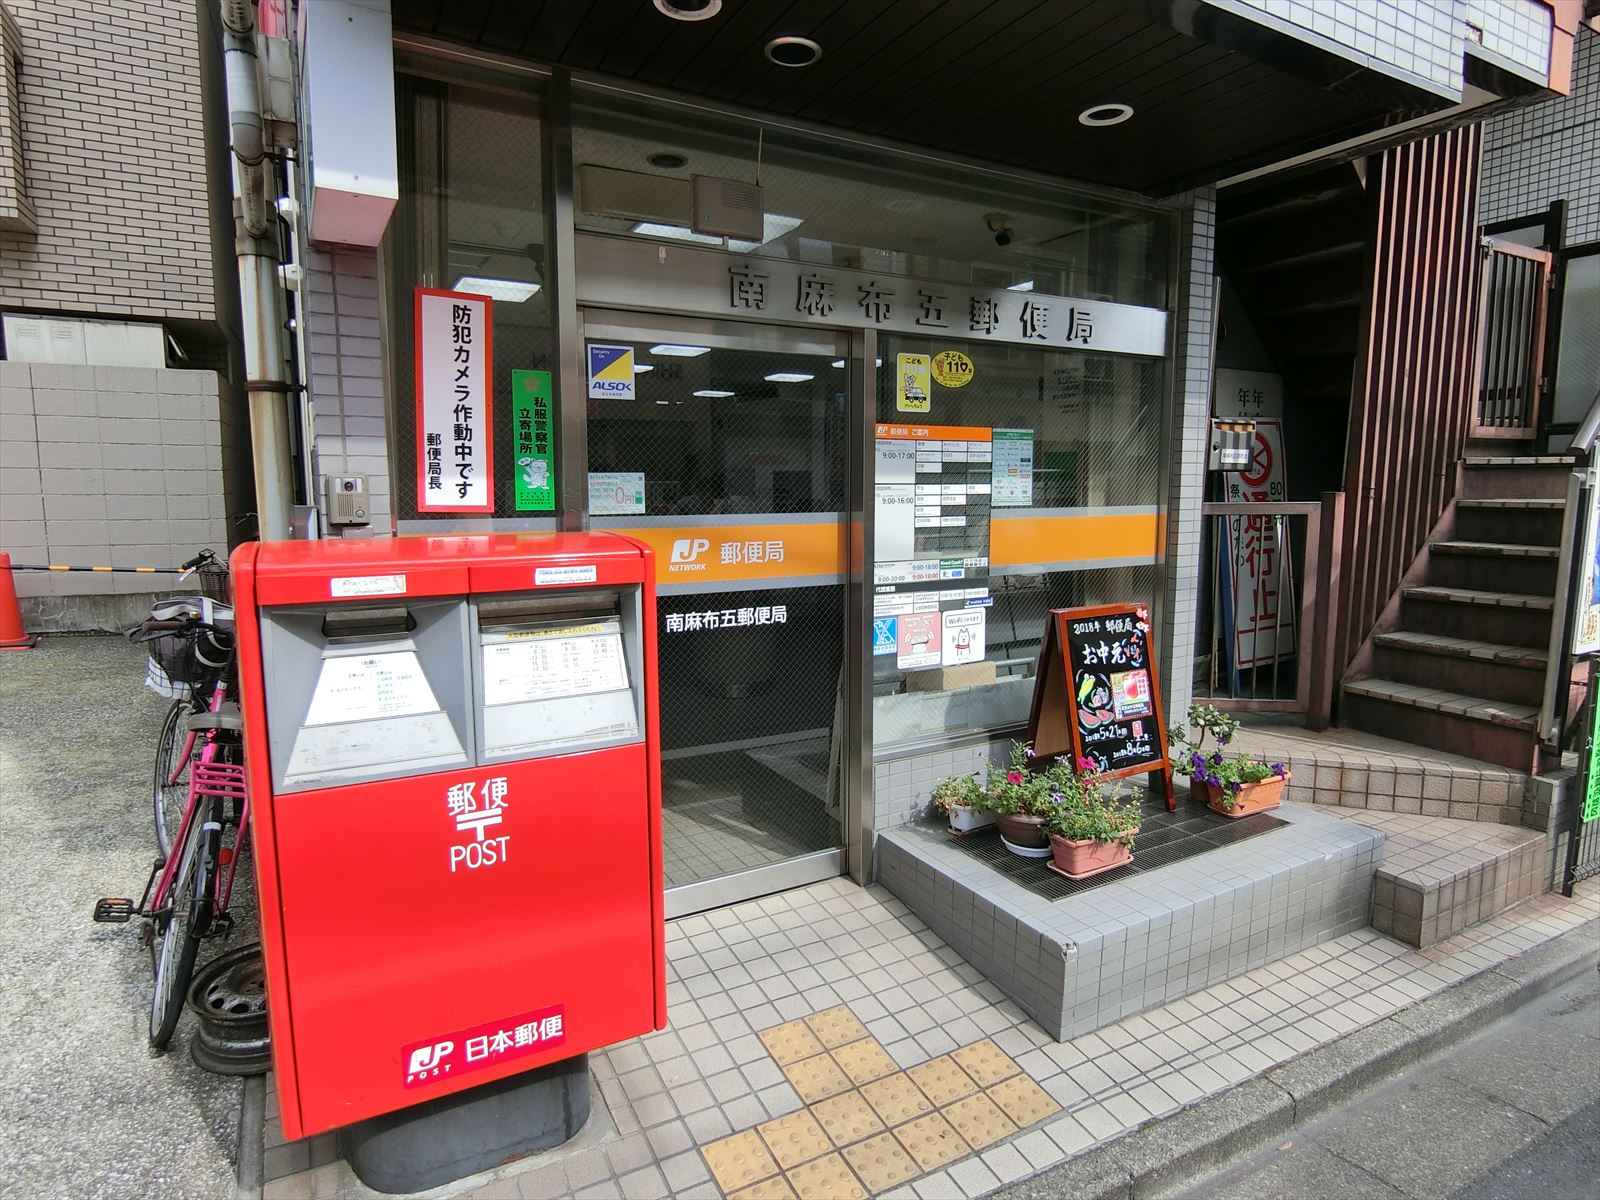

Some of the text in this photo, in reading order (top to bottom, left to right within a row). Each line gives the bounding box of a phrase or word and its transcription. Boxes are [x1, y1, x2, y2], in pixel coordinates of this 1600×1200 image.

[729, 264, 1094, 344] 南麻布五郵便局
[944, 352, 964, 361] 子ども
[592, 381, 632, 392] ALSOK
[452, 304, 473, 499] 防犯カメラ作動中です
[519, 408, 532, 454] 立寄場所
[534, 396, 548, 454] 私服警察官
[427, 432, 442, 490] 郵便局長
[882, 452, 915, 460] 9:00-17:00
[881, 497, 914, 505] 9:00-16:00
[720, 541, 785, 565] 郵便局
[669, 563, 706, 572] NETWORK
[665, 605, 788, 633] 南麻布五郵便局
[1082, 640, 1126, 664] お中元
[447, 776, 509, 816] 郵便
[450, 836, 511, 873] POST
[408, 1014, 564, 1075] JP 日本郵便
[407, 1063, 452, 1083] POST
